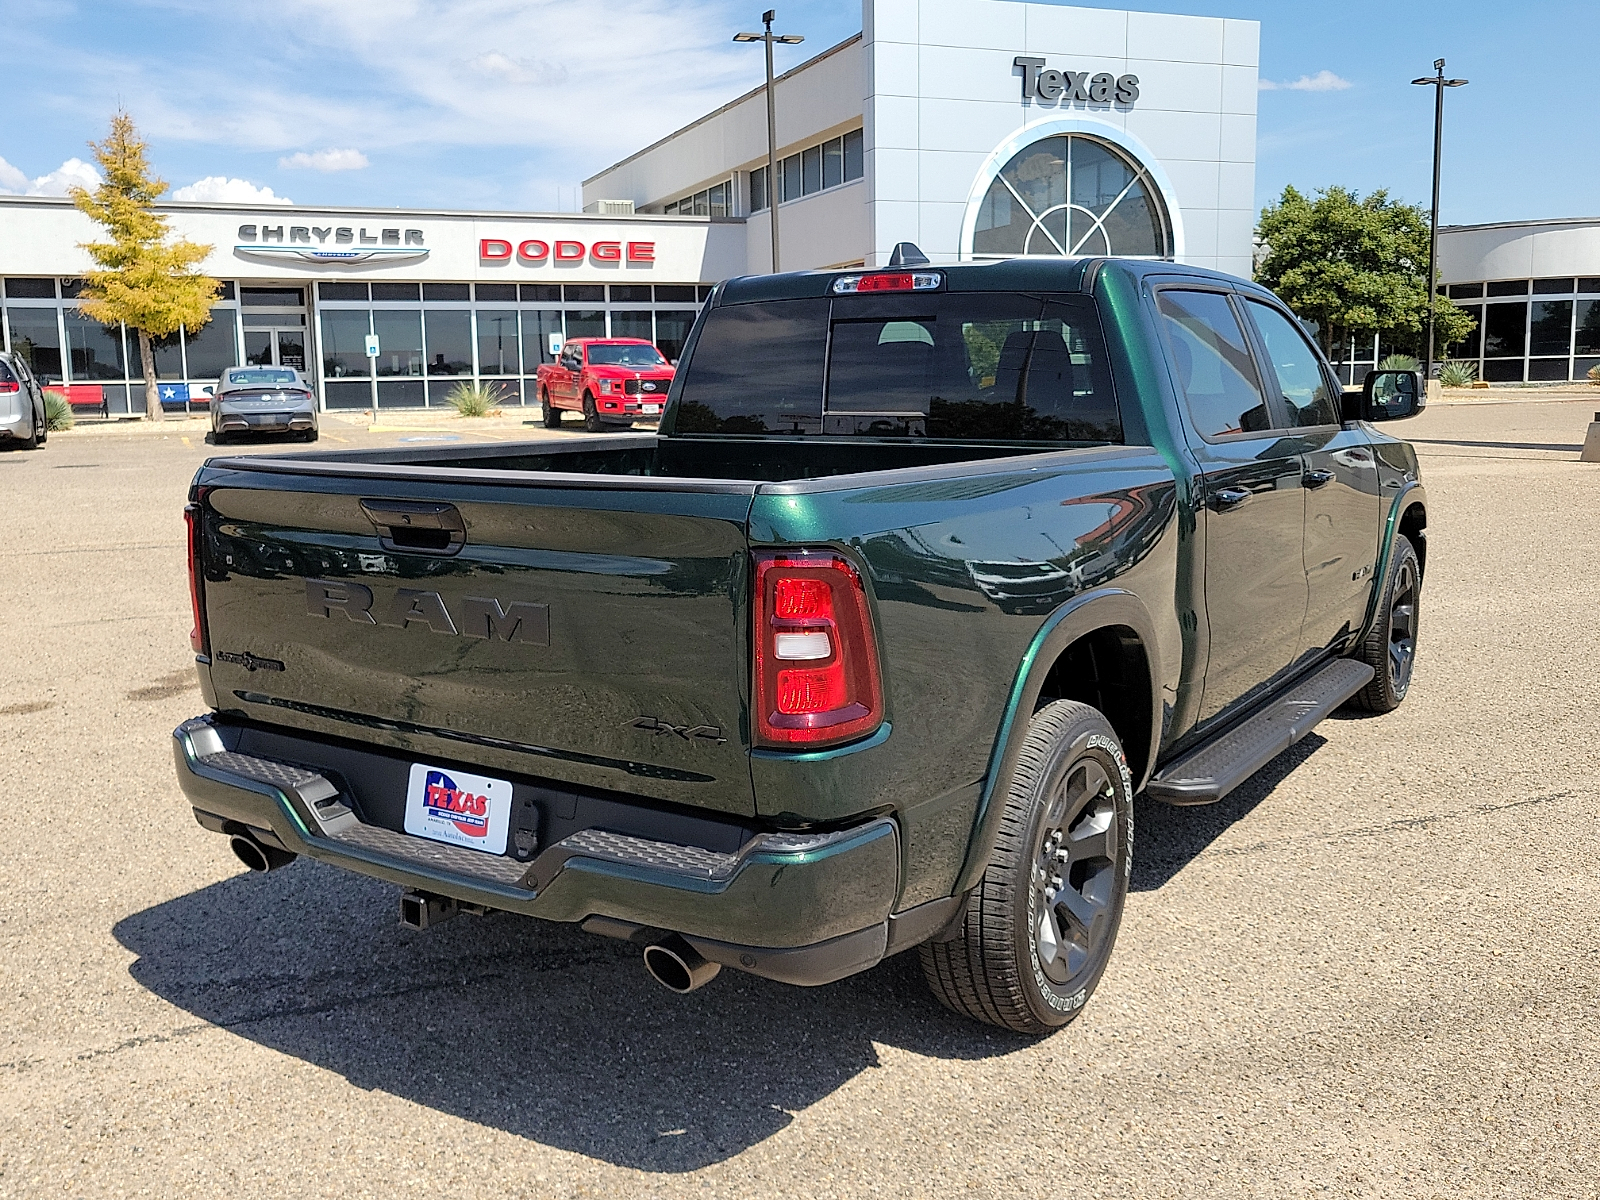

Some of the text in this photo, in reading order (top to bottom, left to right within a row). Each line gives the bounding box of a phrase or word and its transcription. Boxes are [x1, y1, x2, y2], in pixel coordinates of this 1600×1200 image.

[1013, 56, 1140, 103] Texas
[238, 224, 425, 244] CHRYSLER
[480, 239, 656, 262] DODGE
[305, 577, 550, 647] RAM
[1087, 735, 1132, 802] DUELER
[427, 785, 487, 816] TEXAS
